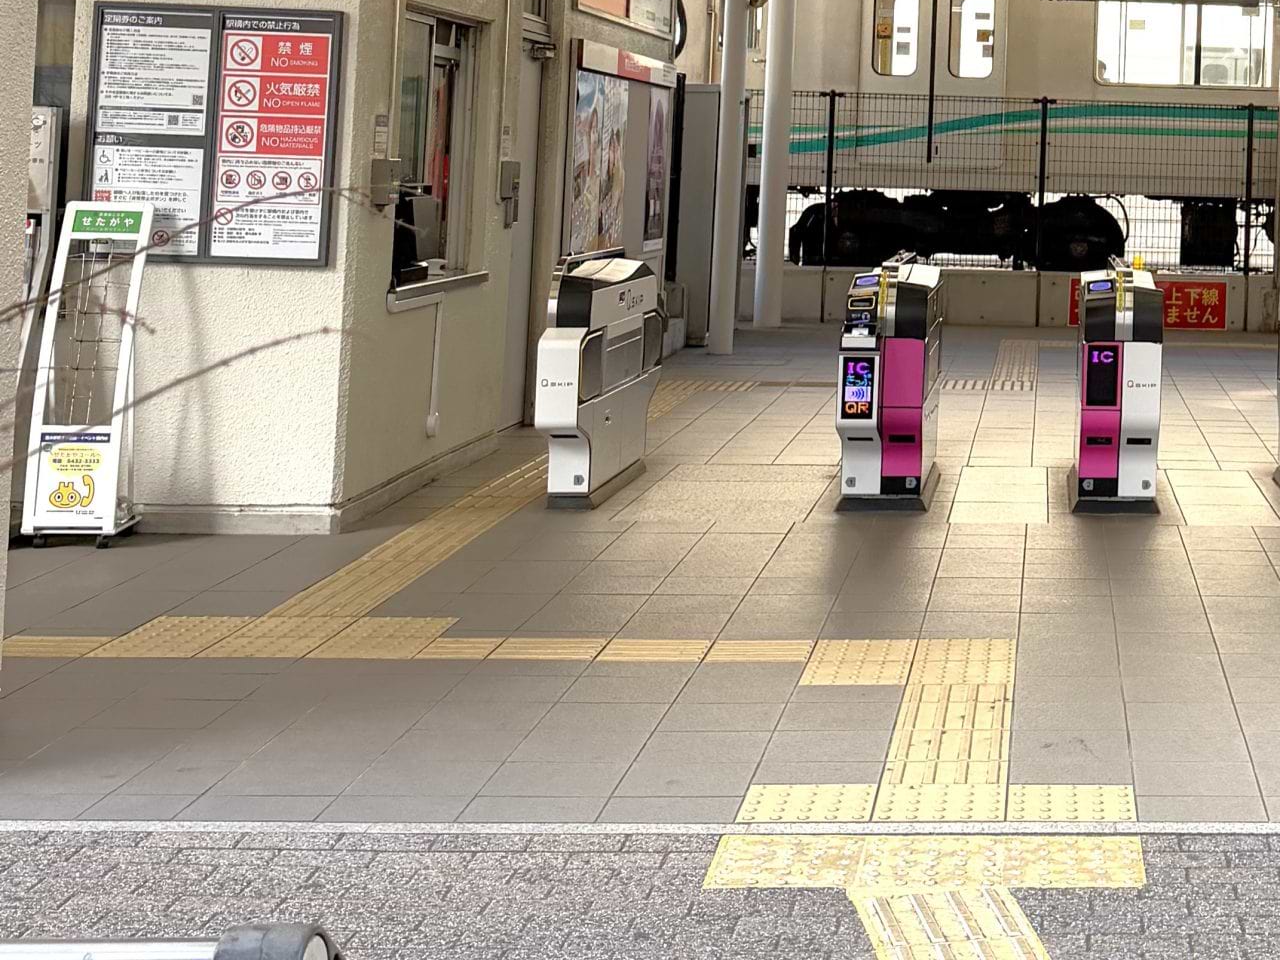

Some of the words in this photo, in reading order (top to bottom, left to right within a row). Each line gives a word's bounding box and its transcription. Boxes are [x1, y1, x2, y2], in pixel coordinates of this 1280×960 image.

[225, 19, 300, 31] 駅構内での禁止行為
[278, 41, 313, 56] 禁煙
[270, 57, 289, 67] NO
[265, 82, 320, 97] 火気厳禁
[263, 98, 281, 108] NO
[261, 136, 280, 147] NO
[82, 216, 134, 227] せたがや
[1165, 287, 1220, 306] 上下線
[1167, 306, 1218, 324] ません
[1092, 351, 1114, 363] IC
[848, 362, 870, 374] IC
[845, 401, 869, 414] QR
